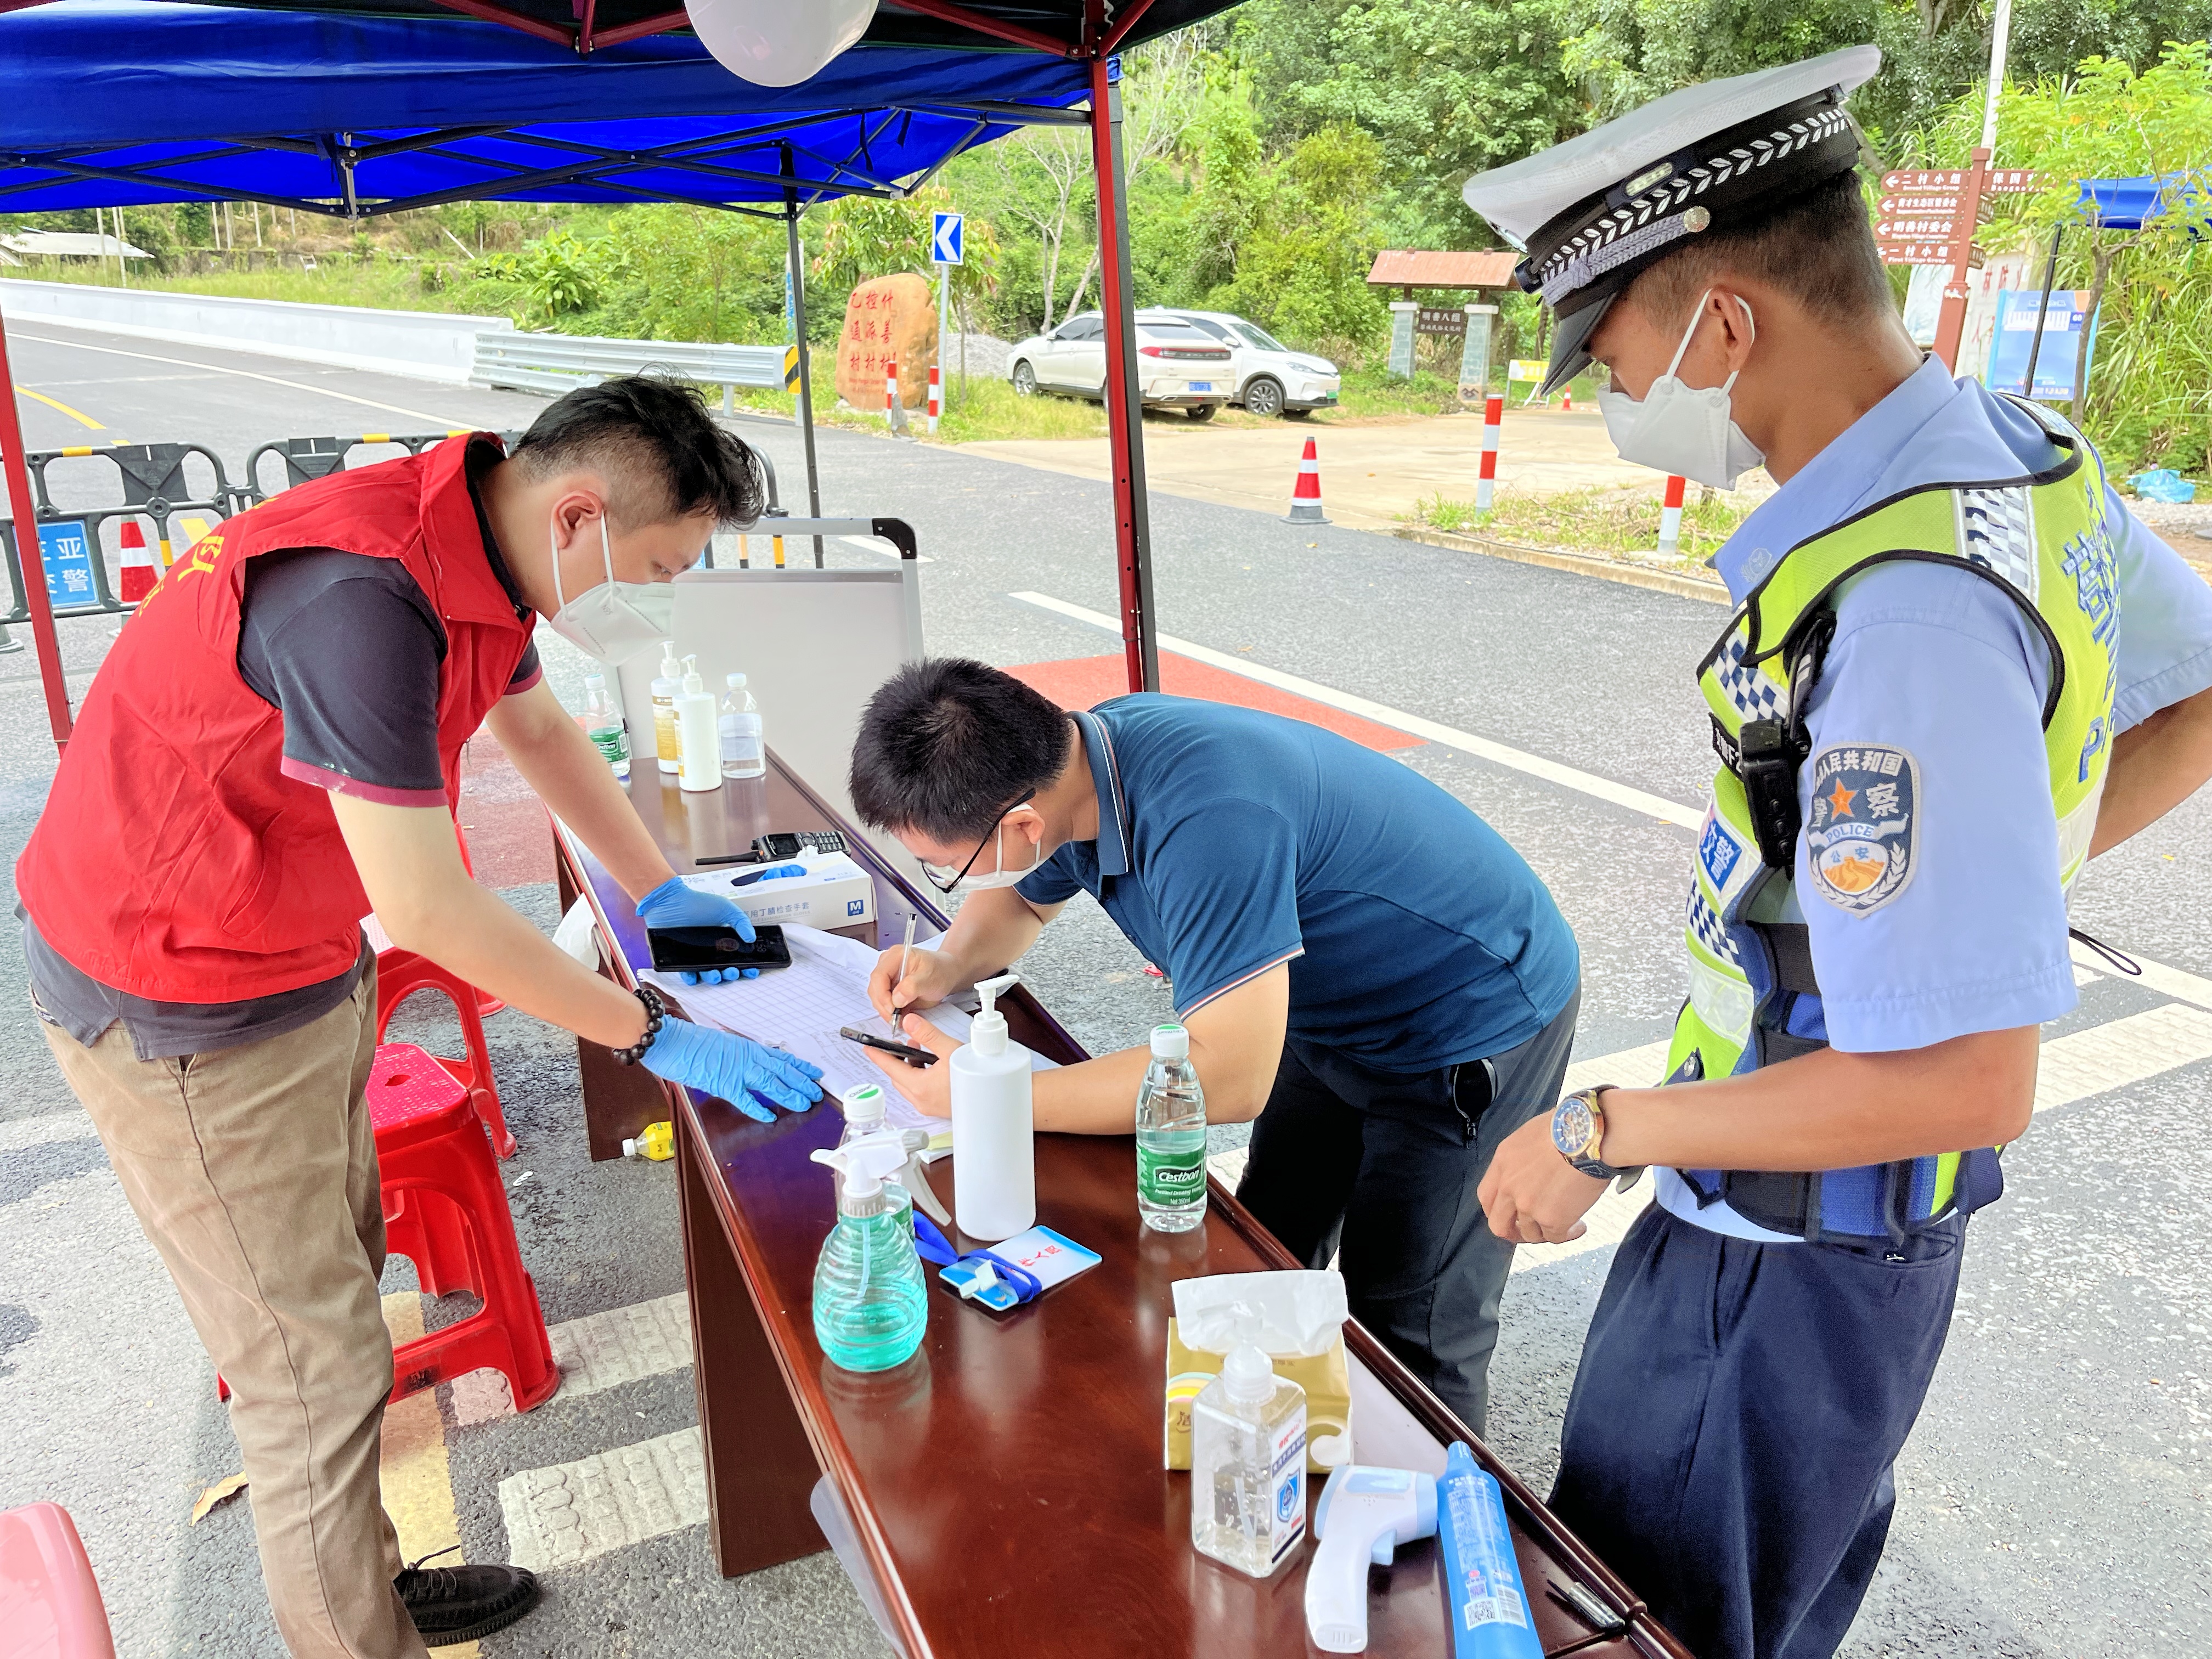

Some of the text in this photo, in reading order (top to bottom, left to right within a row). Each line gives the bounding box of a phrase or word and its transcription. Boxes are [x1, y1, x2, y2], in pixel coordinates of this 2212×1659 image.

[1901, 173, 1961, 185] 二村小组
[1893, 221, 1953, 233] 明善村委会
[1889, 245, 1949, 257] 一村小组
[1826, 825, 1875, 843] POLICE
[850, 901, 861, 911] M
[1158, 1169, 1200, 1183] C'estbon
